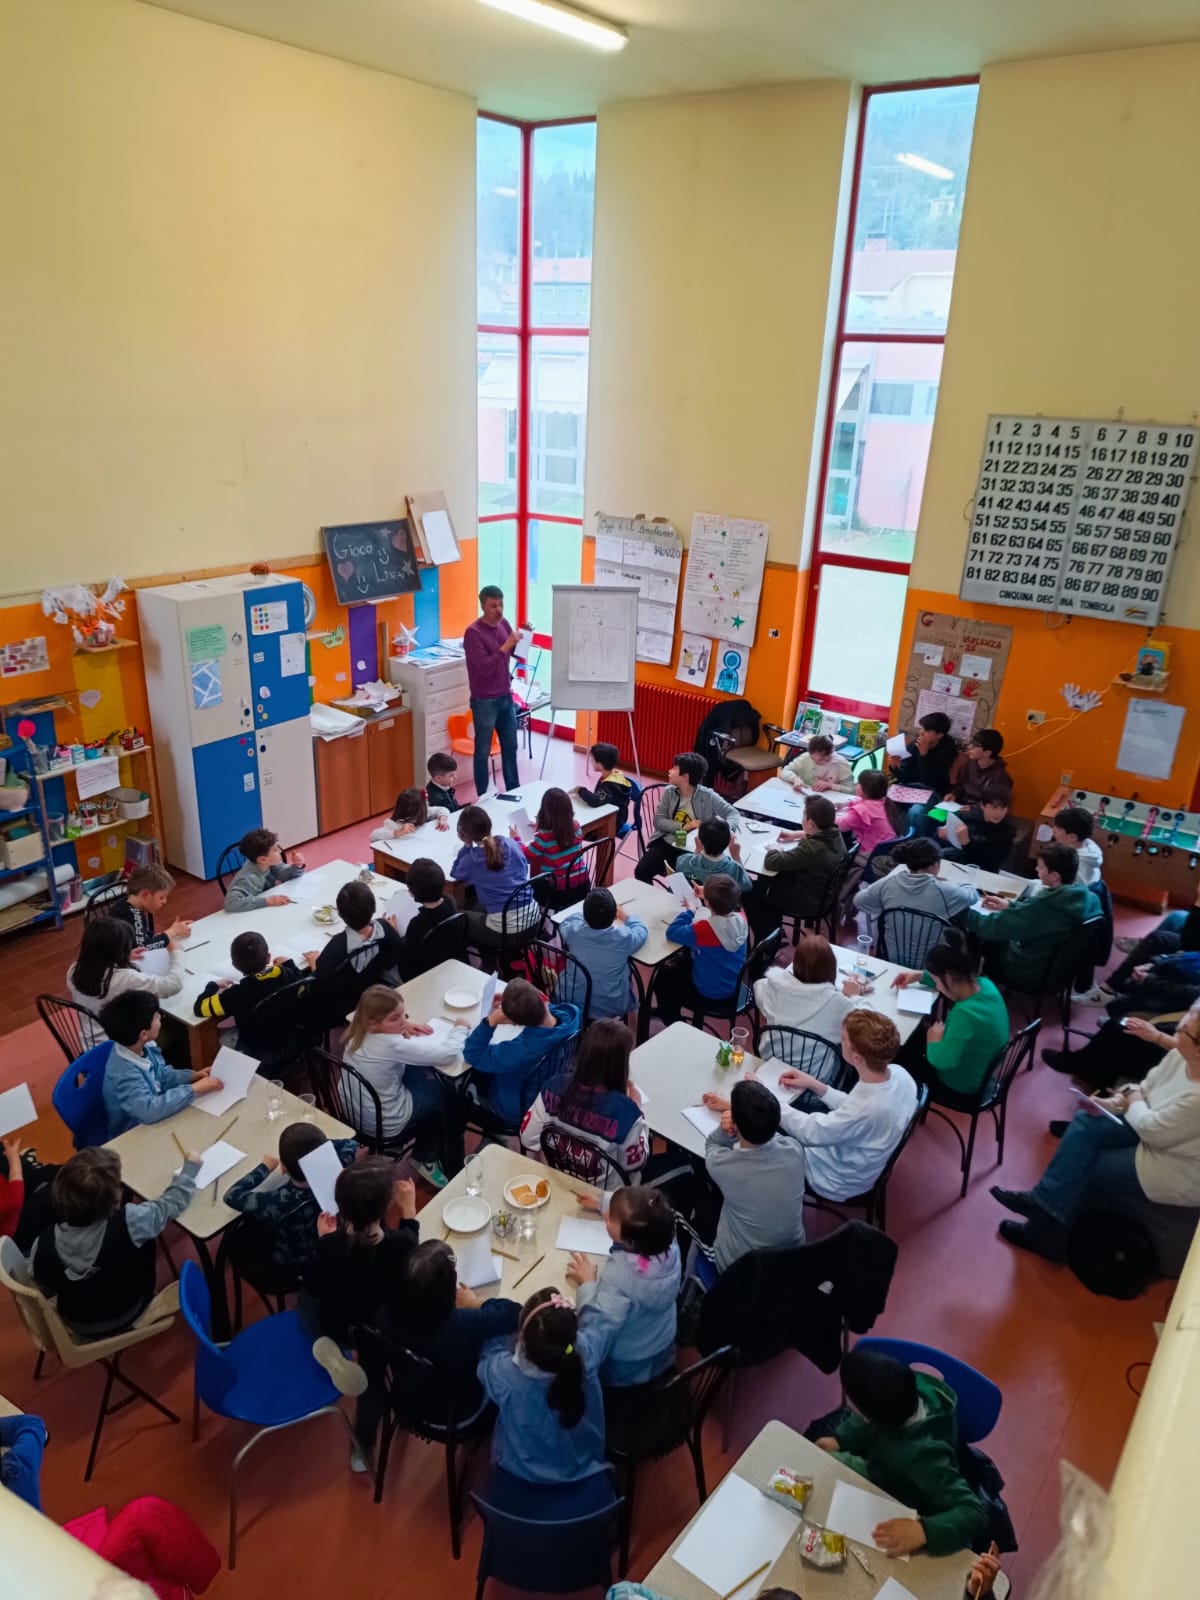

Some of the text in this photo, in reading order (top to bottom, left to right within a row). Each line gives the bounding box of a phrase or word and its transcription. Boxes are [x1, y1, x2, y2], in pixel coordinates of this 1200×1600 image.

[996, 421, 1194, 448] 1 2 3 4 5 6 7 8 9 10
[989, 440, 1189, 468] 11 12 13 14 15 16 17 18 19 20
[984, 459, 1184, 488] 21 22 23 24 25 26 27 28 29 30
[981, 477, 1180, 507] 31 32 33 34 35 36 37 38 39 40
[977, 496, 1176, 527] 41 42 43 44 45 46 47 48 49 50
[975, 514, 1172, 546] 51 52 53 54 55 56 57 58 59 60
[972, 532, 1167, 565] 61 62 63 64 65 66 67 68 69 70
[970, 549, 1163, 583] 71 72 73 74 75 76 77 78 79 80
[966, 566, 1159, 602] 81 82 83 84 85 86 87 88 89 90
[999, 590, 1034, 603] CINQUINA
[1036, 594, 1054, 604] DEC
[1080, 600, 1115, 613] TOMBOLA
